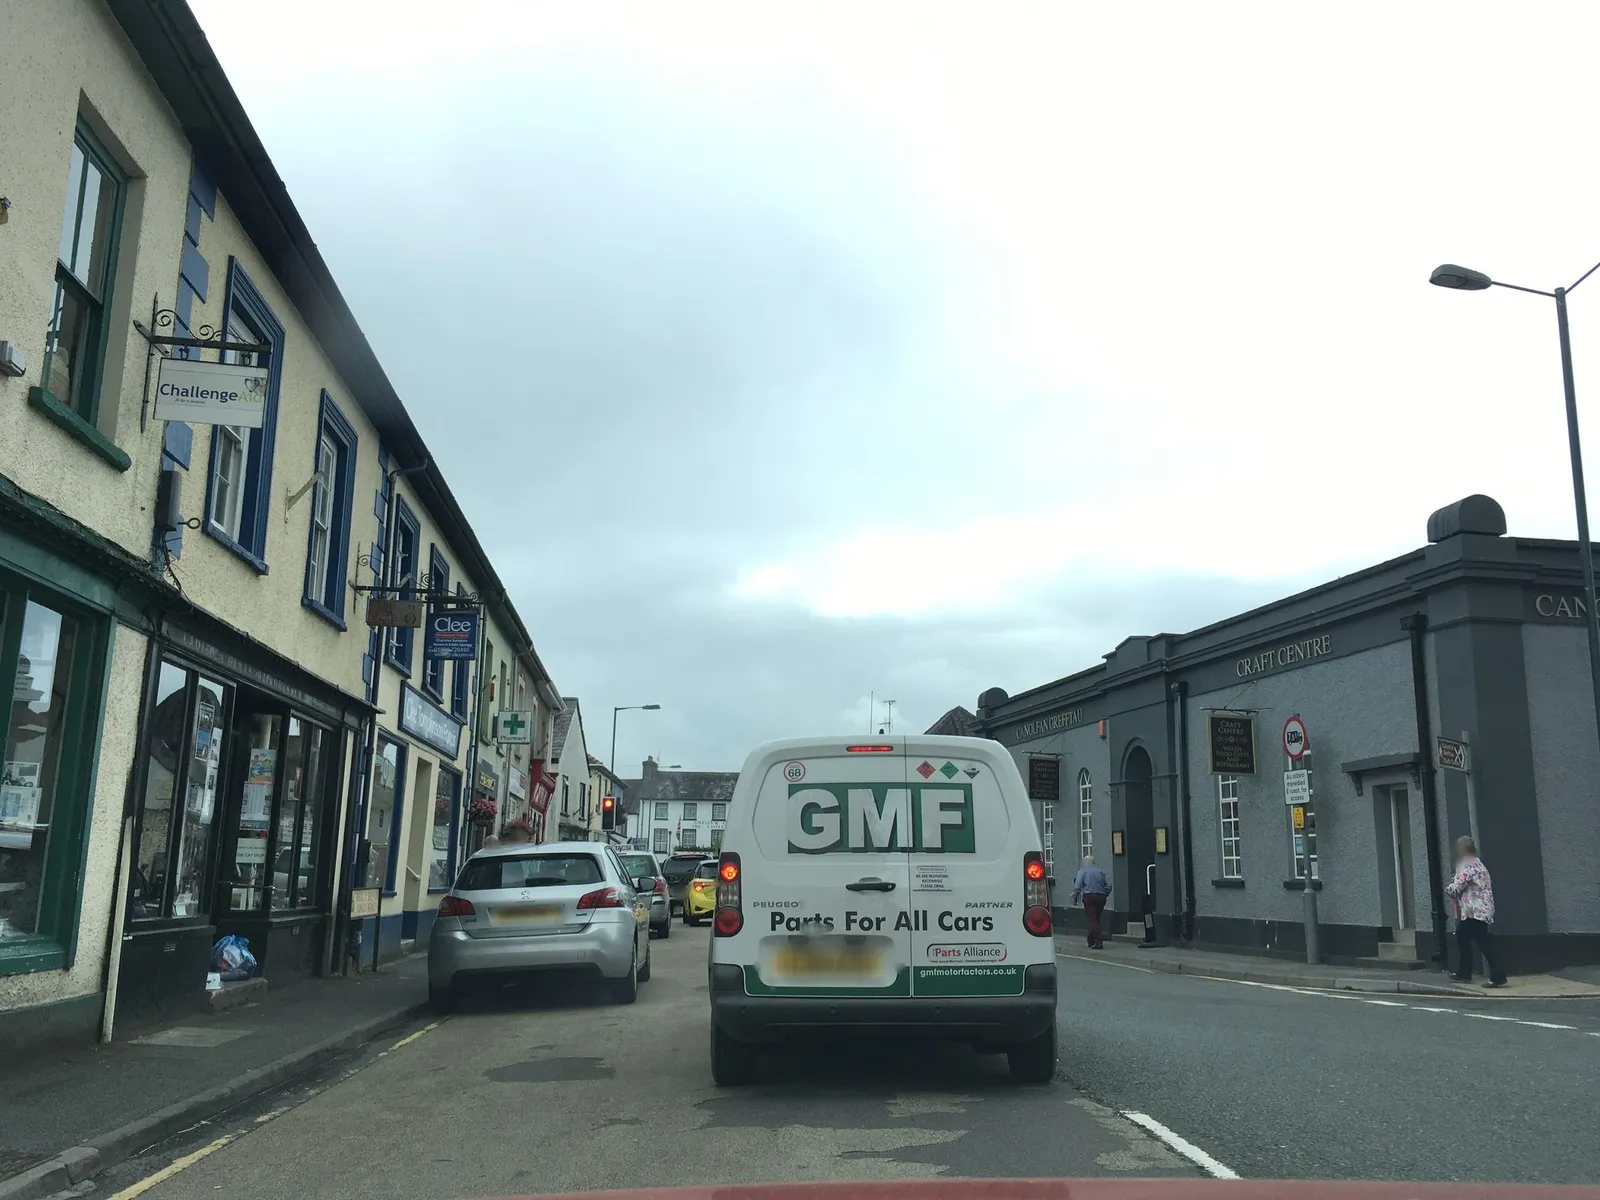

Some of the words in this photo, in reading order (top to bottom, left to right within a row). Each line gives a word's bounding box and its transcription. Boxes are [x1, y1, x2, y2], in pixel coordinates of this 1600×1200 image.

[1535, 594, 1600, 618] CAN
[434, 617, 471, 632] Clee
[1236, 650, 1276, 677] CRAFT
[1277, 634, 1332, 666] CENTRE
[1016, 716, 1049, 740] CANOLFAN
[1048, 707, 1084, 731] GREFFTAU
[788, 768, 801, 778] 68
[788, 788, 966, 852] GMF
[965, 901, 1013, 909] PARTNER
[770, 911, 834, 932] Parts
[845, 911, 886, 932] For
[893, 909, 928, 932] All
[937, 910, 994, 932] Cars
[935, 948, 961, 957] Parts
[963, 946, 1001, 957] Alliance
[920, 967, 1017, 978] gmfmotorfactors.co.uk
